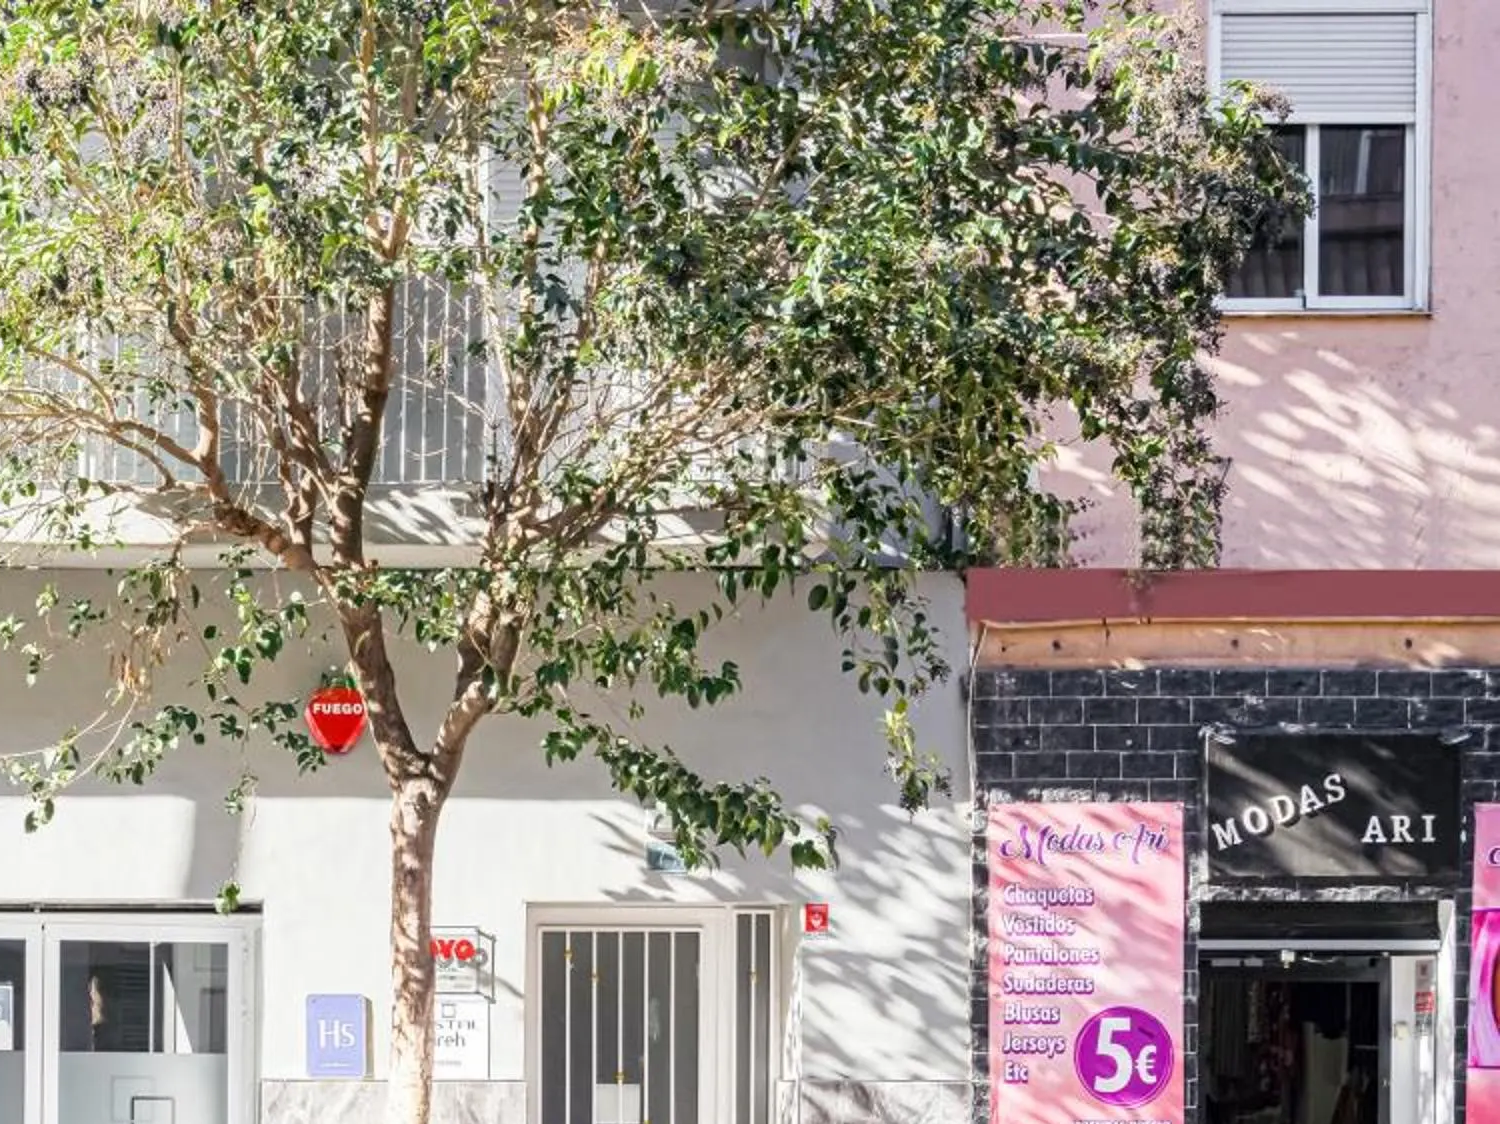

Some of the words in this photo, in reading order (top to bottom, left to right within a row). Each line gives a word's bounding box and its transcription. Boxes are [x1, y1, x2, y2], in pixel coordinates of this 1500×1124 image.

[312, 702, 363, 715] FUEGO
[1212, 773, 1347, 851] MODAS
[1361, 814, 1437, 843] ARI
[1003, 885, 1095, 909] Chaquetas
[1003, 914, 1076, 936] Vestidos
[1004, 943, 1101, 965] Pantalones
[1003, 972, 1095, 994] Sudaderas
[1004, 1003, 1061, 1024] Blusas
[318, 1019, 356, 1049] Hs
[1003, 1033, 1066, 1058] Jerseys
[1094, 1016, 1157, 1093] 5€
[1004, 1062, 1029, 1083] Etc
